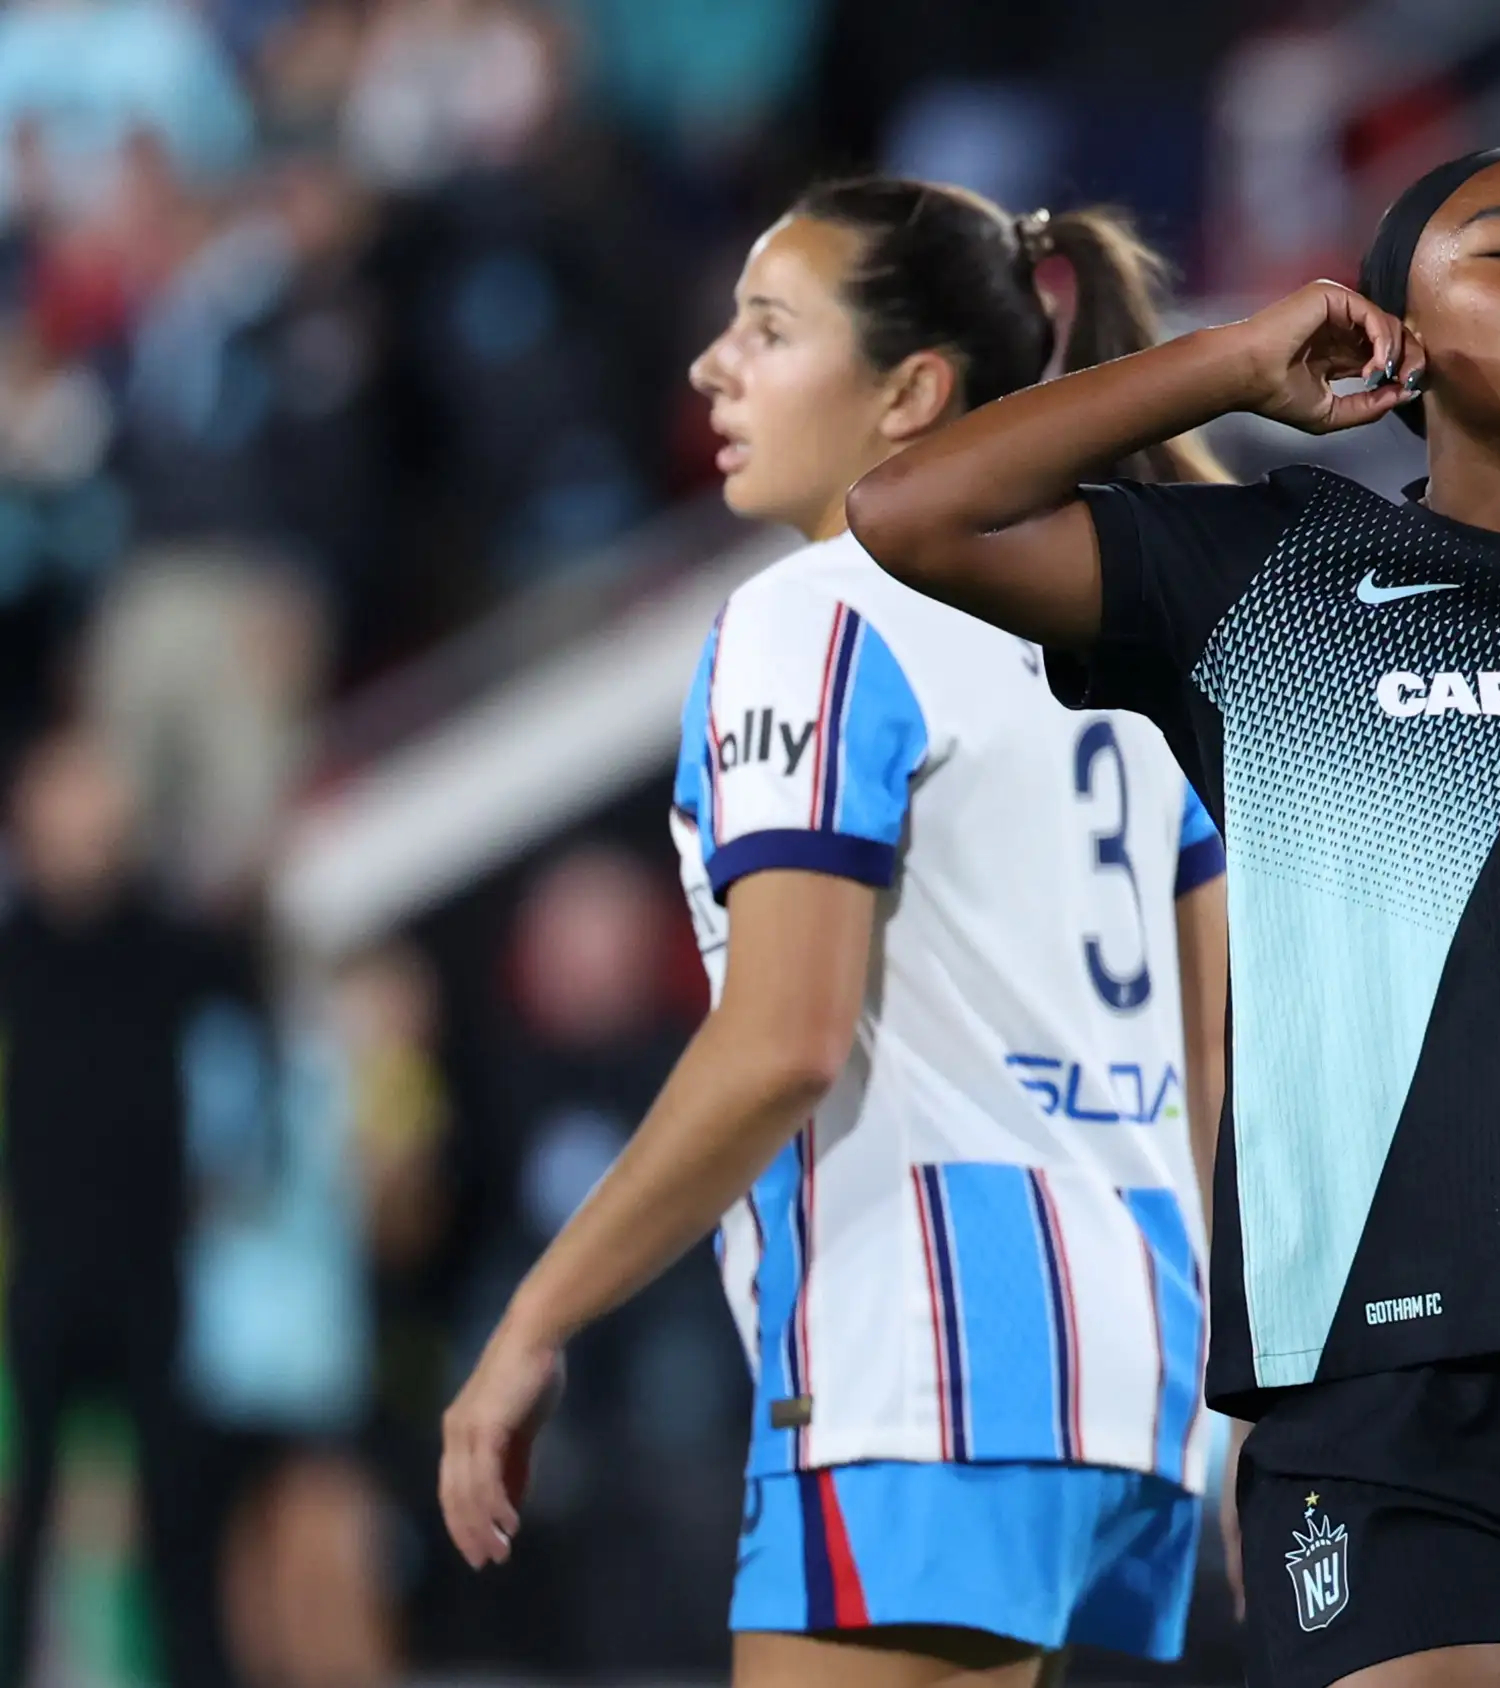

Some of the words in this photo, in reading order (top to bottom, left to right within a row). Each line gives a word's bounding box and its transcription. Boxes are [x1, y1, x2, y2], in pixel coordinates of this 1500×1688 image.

[718, 708, 816, 776] ally
[1074, 720, 1152, 1011] 3
[1365, 1295, 1424, 1325] GOTHAM
[1425, 1292, 1443, 1316] FC
[1303, 1552, 1340, 1619] NY
